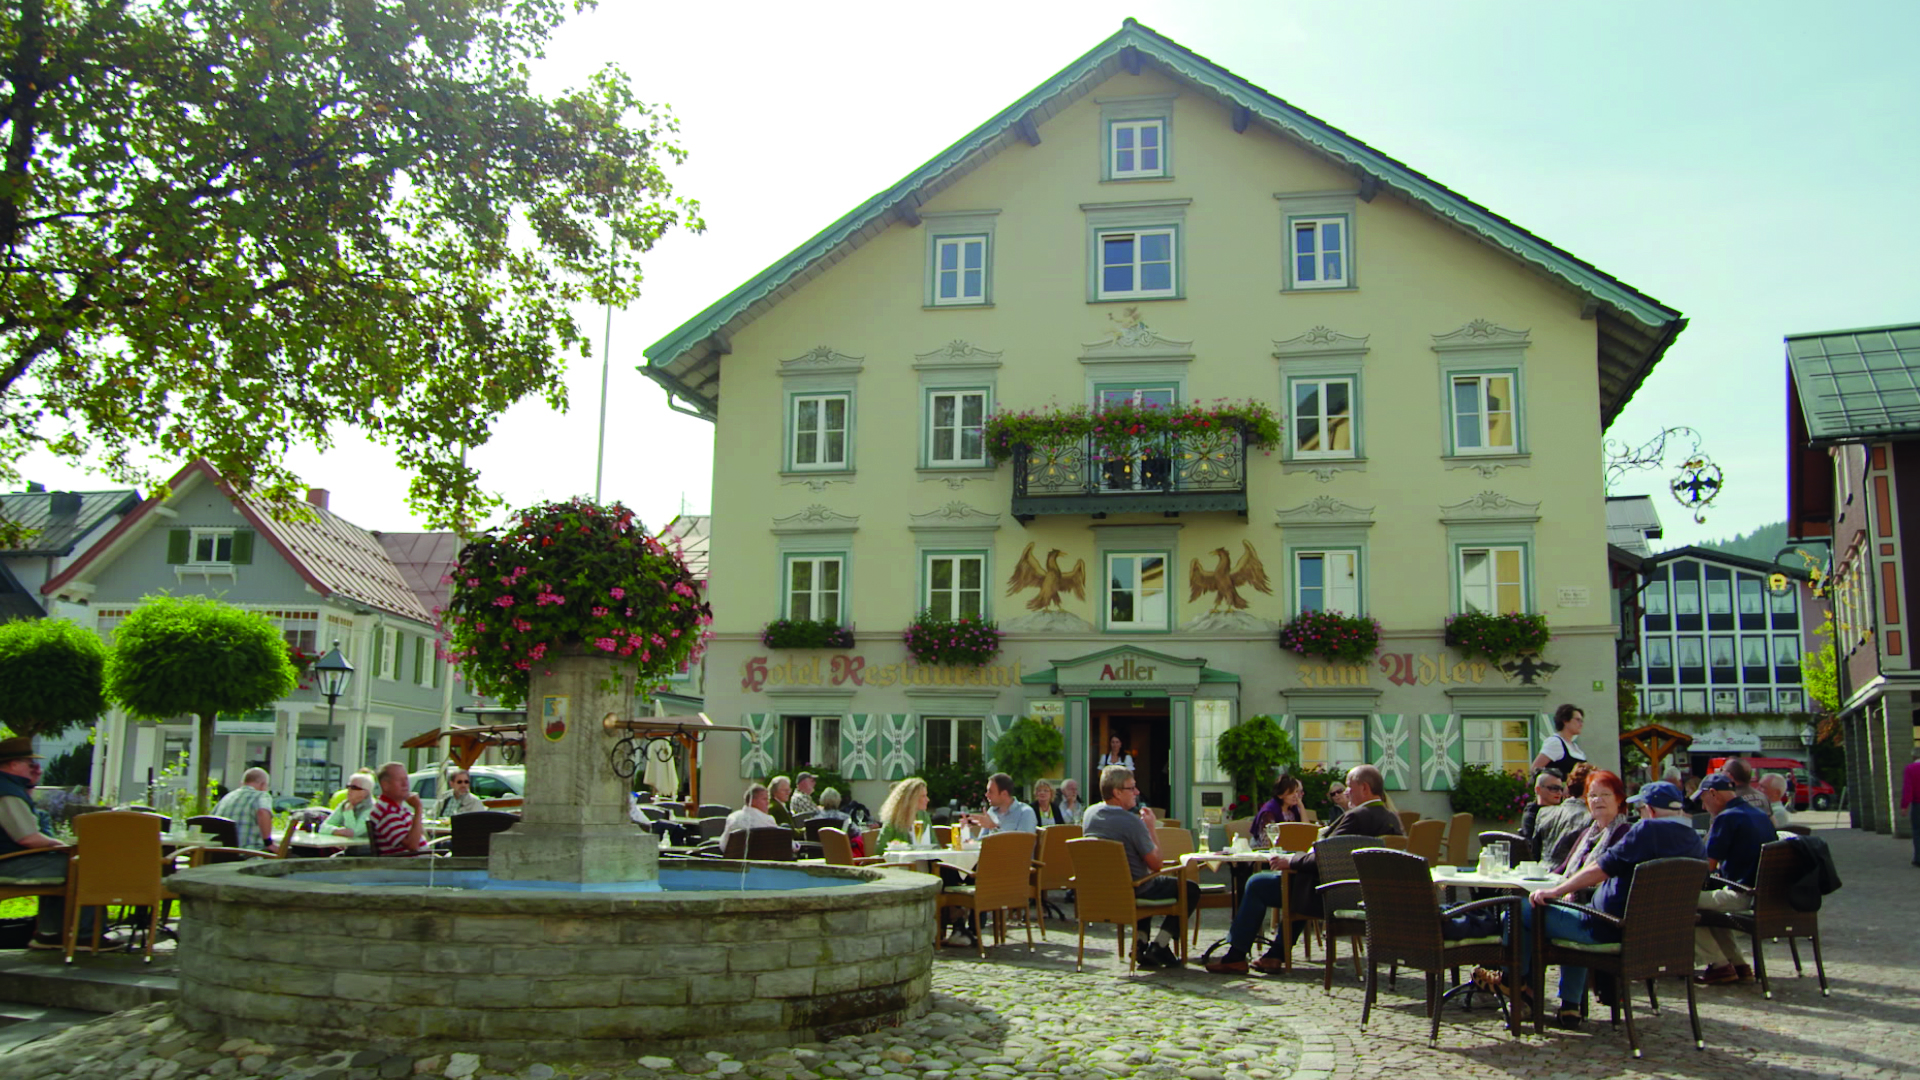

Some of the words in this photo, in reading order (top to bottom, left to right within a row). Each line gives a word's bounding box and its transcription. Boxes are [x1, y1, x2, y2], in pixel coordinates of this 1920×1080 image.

[741, 655, 822, 693] Hotel
[830, 655, 1022, 688] Restaurant
[1099, 658, 1157, 681] Adler
[1298, 663, 1370, 689] zum
[1379, 653, 1487, 687] Adler
